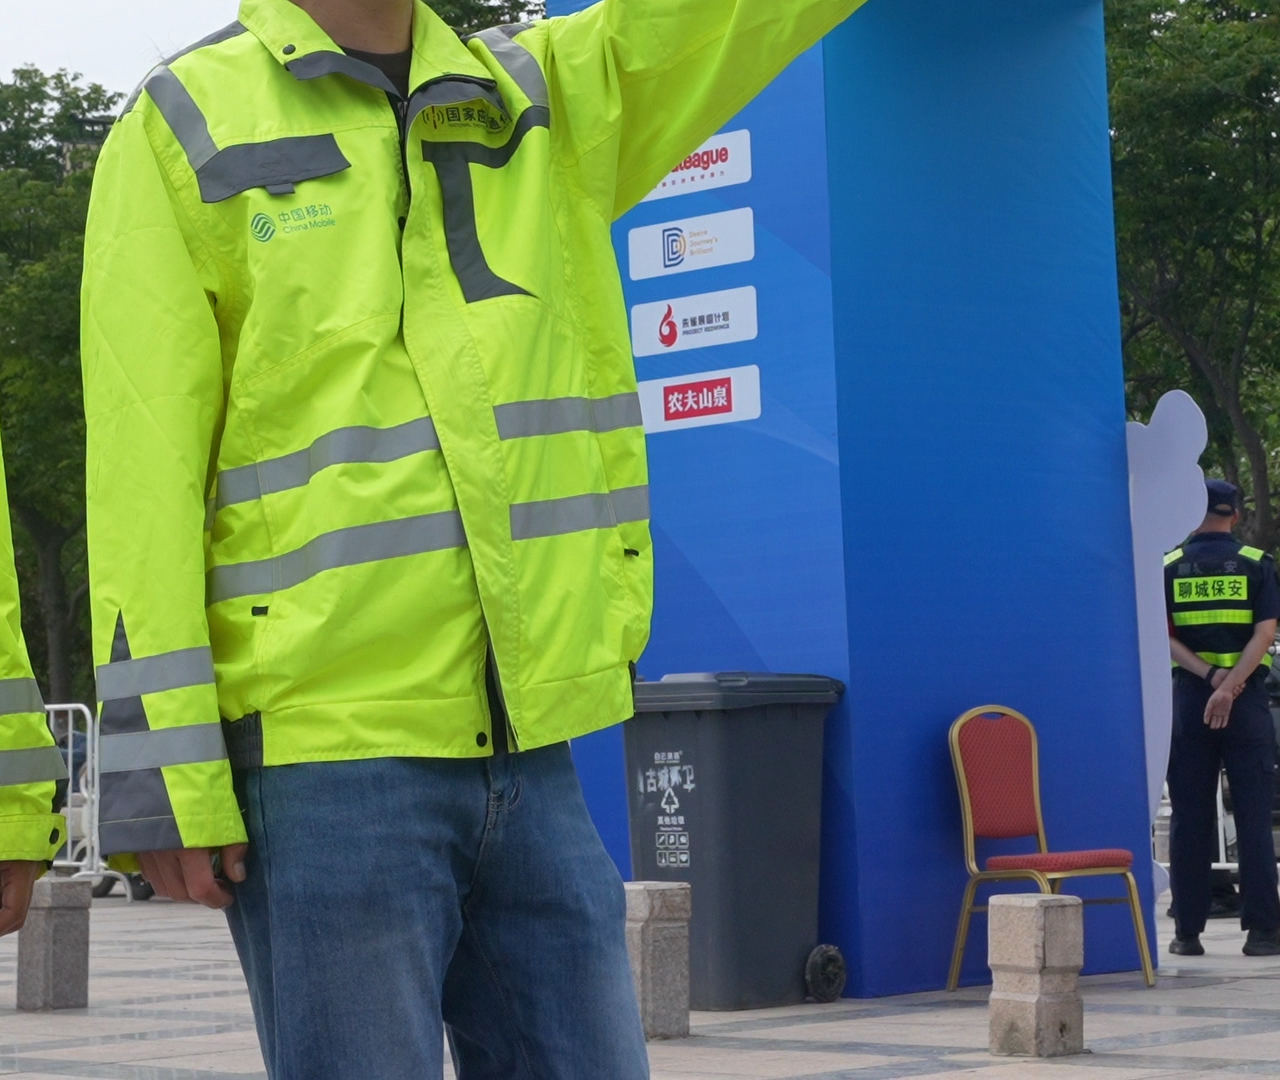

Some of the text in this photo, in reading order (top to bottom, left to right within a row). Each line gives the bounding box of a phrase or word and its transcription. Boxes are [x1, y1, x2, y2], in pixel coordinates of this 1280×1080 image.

[278, 204, 332, 224] 中国移动
[283, 218, 336, 234] China Mobile
[667, 385, 728, 414] 农夫山泉
[1178, 579, 1243, 599] 聊城保安
